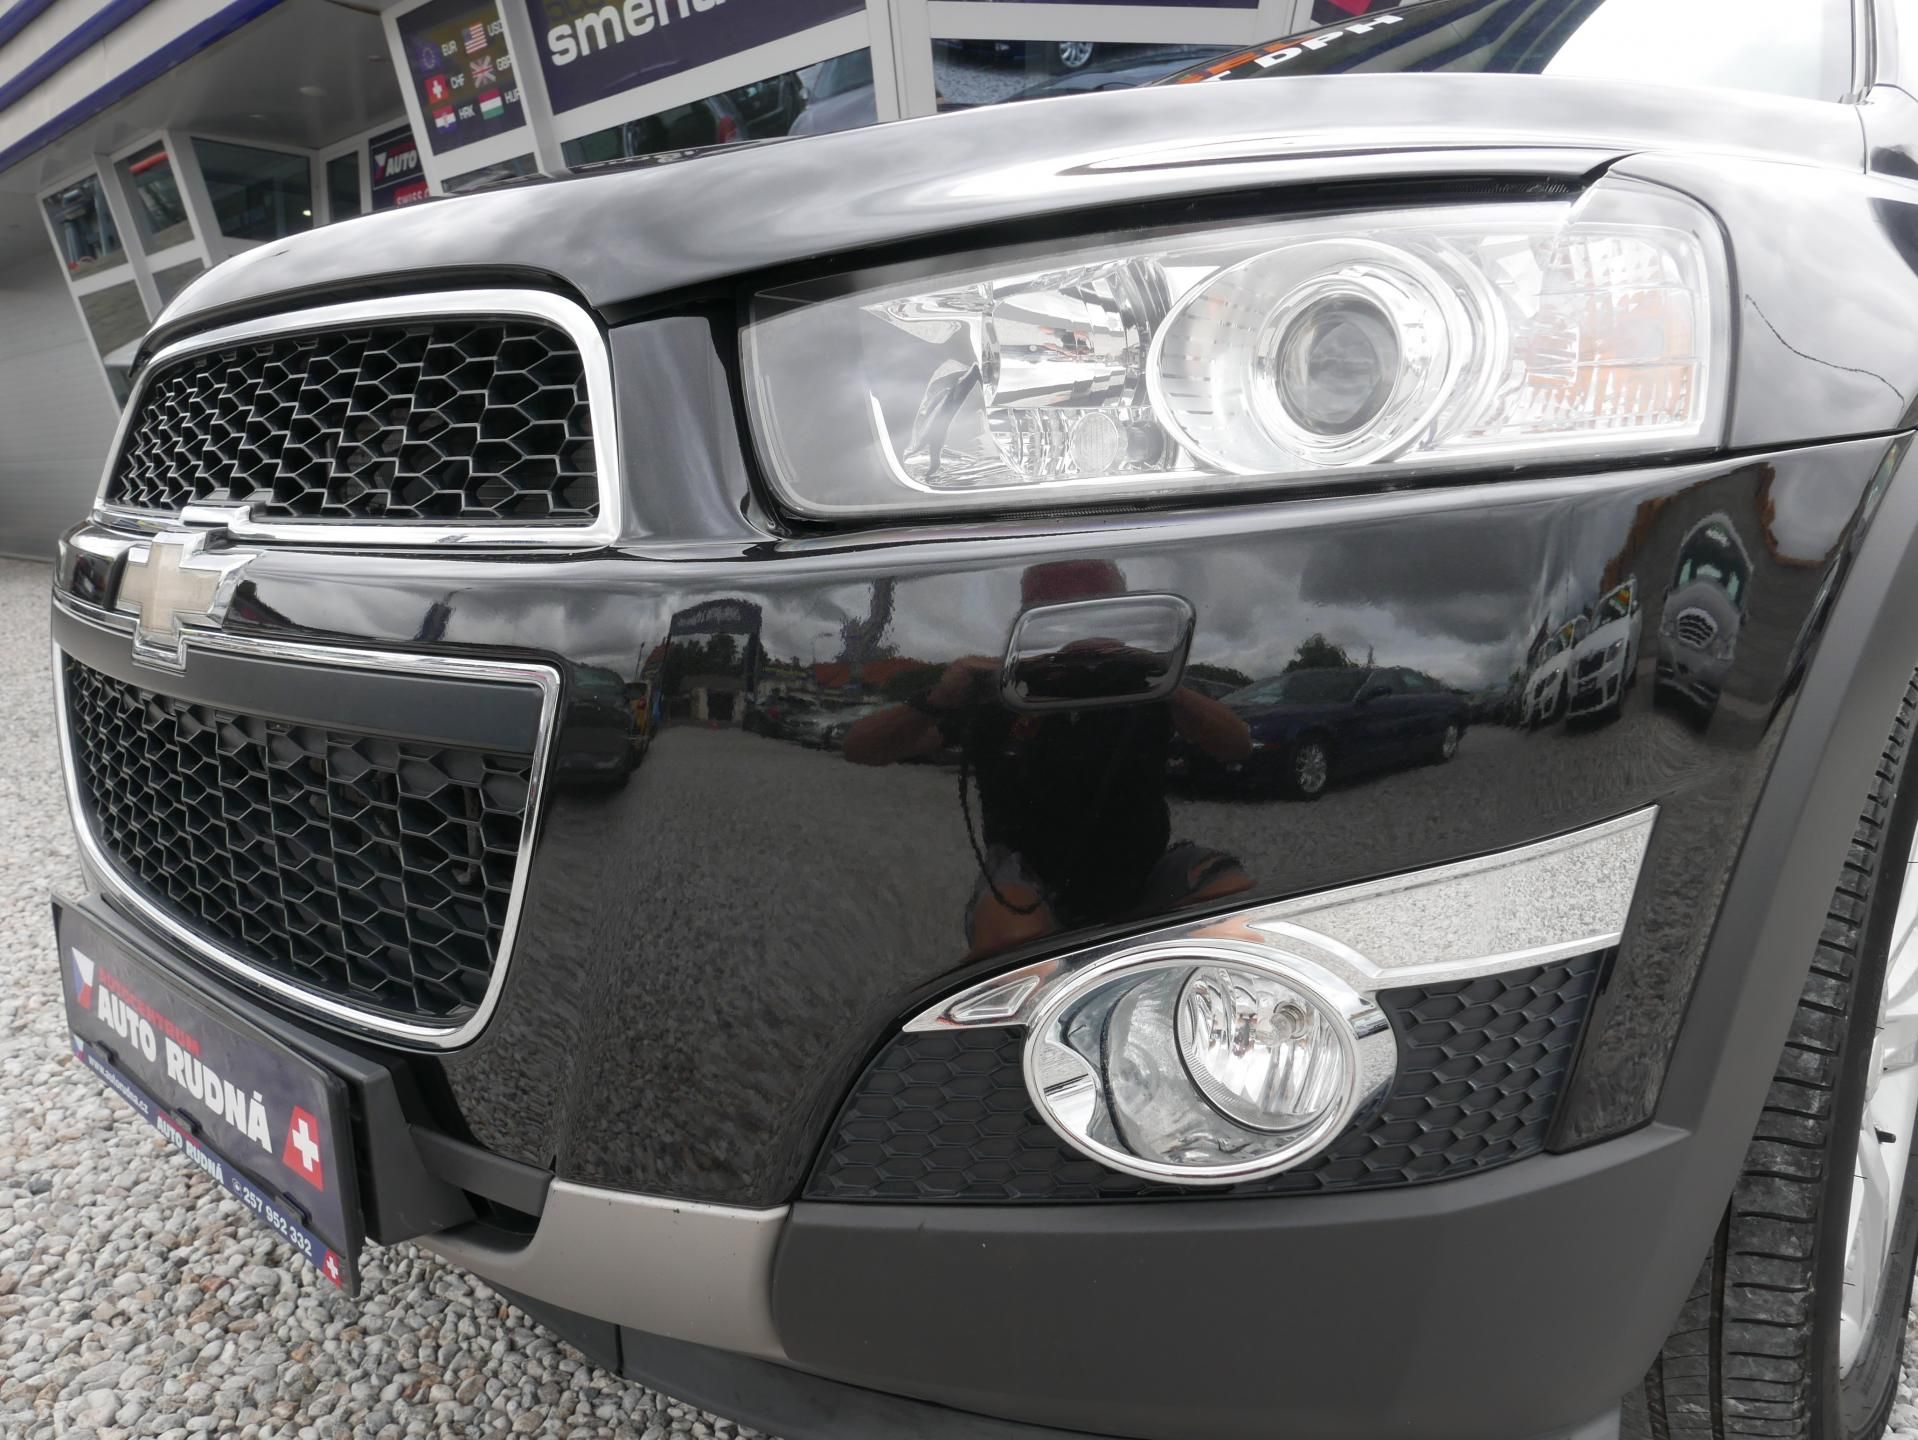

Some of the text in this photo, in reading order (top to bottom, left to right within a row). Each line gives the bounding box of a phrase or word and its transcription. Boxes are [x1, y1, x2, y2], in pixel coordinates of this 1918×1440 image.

[441, 40, 458, 56] EUR
[1254, 14, 1403, 69] DPH
[450, 73, 465, 89] CHF
[458, 104, 476, 120] HRK
[385, 149, 418, 177] AUTO
[98, 984, 157, 1063] AUTO
[165, 1036, 273, 1154] RUDNÁ
[157, 1115, 183, 1149] AUTO
[186, 1141, 224, 1186] RUDNÁ
[242, 1187, 312, 1257] 257 952 332
